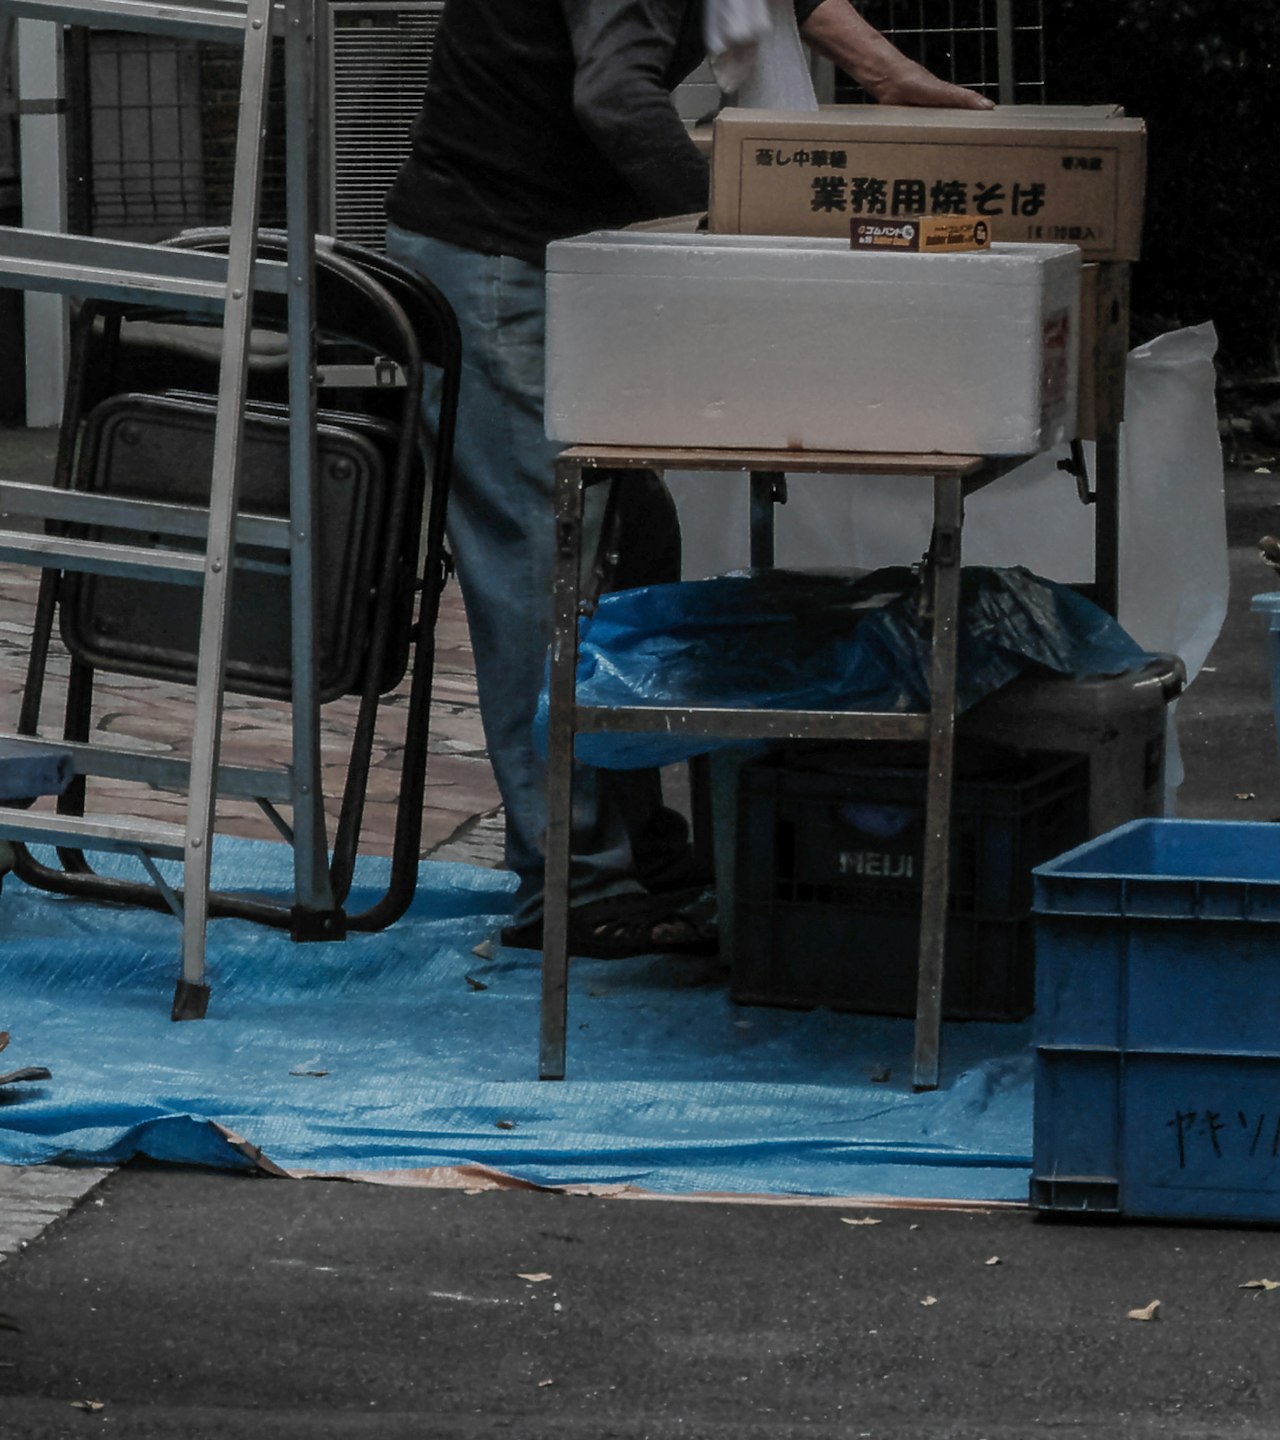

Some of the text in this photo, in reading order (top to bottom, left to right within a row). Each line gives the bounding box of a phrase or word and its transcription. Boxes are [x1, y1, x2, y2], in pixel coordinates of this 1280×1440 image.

[810, 176, 1046, 217] 業務用焼そば
[838, 850, 914, 879] MEIJI
